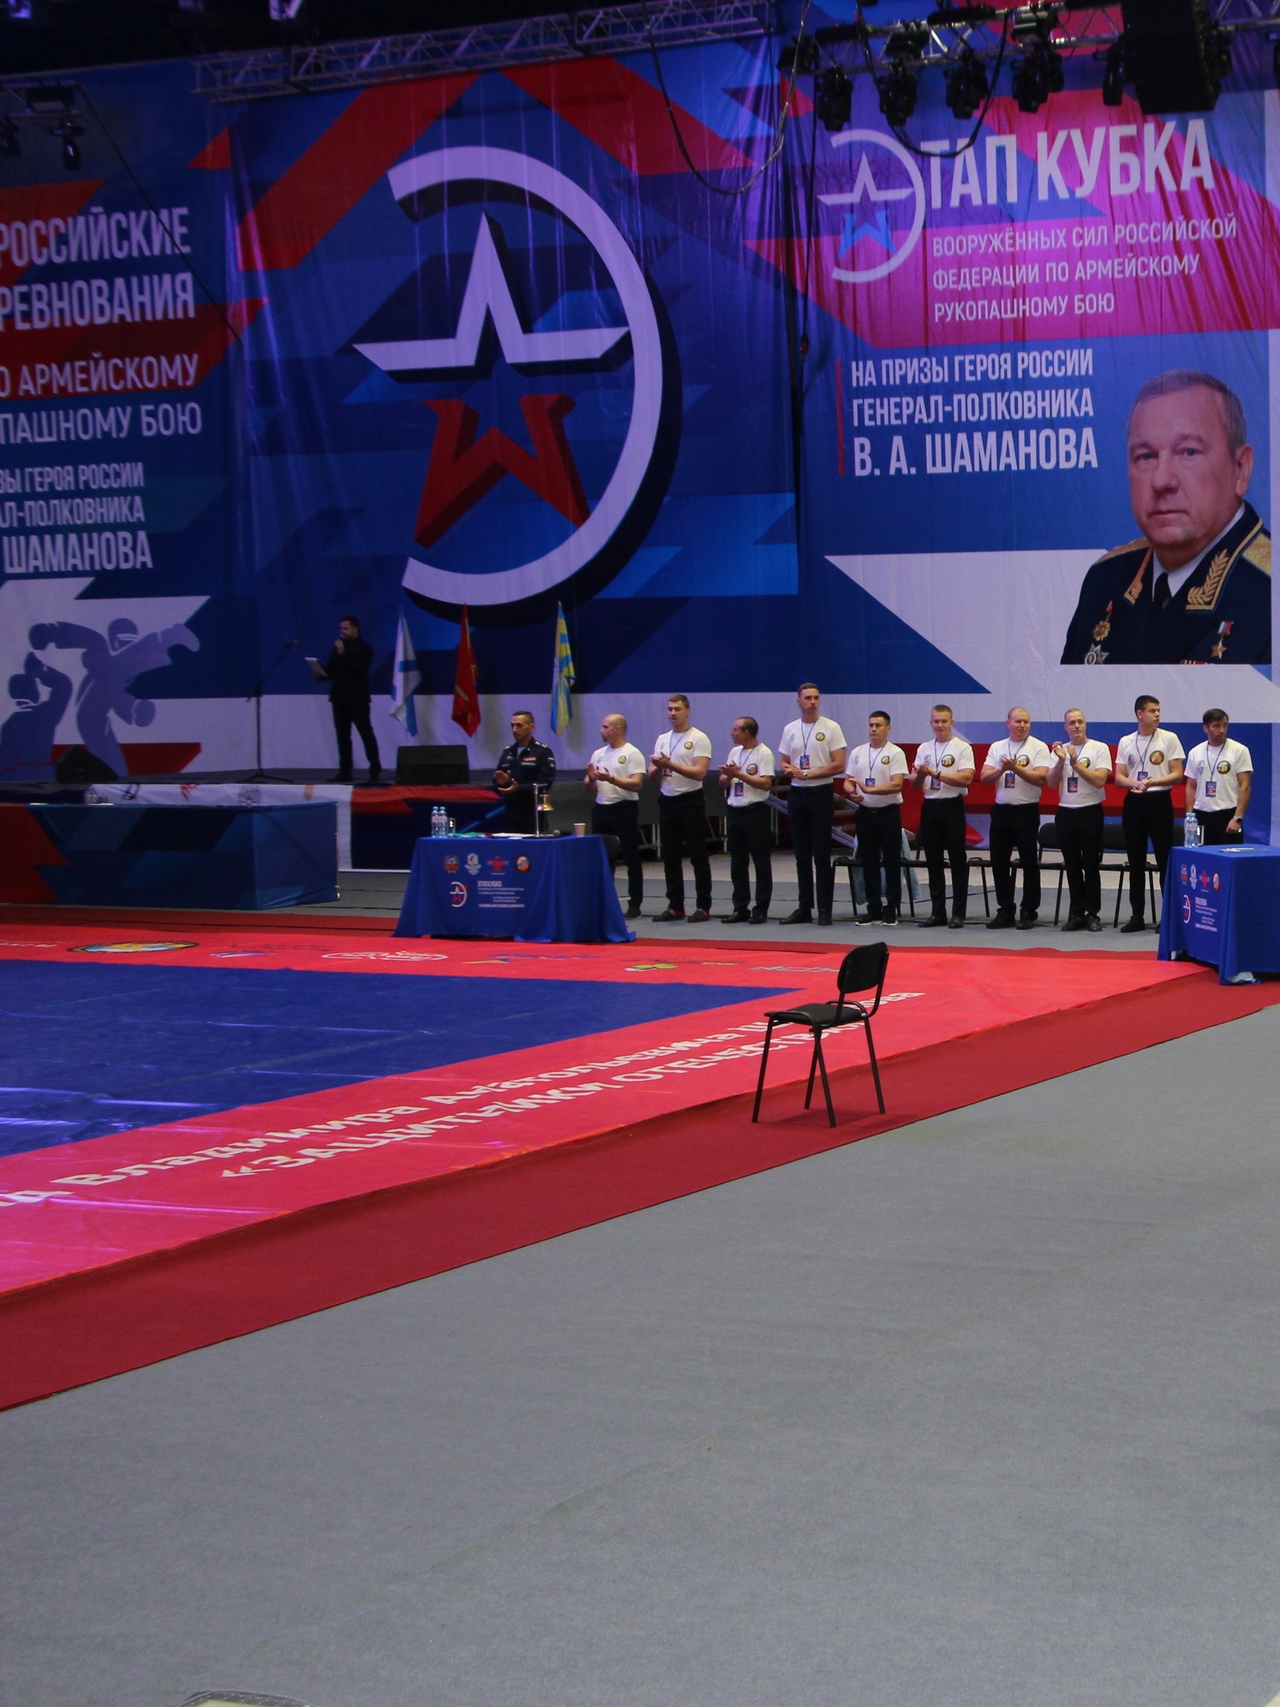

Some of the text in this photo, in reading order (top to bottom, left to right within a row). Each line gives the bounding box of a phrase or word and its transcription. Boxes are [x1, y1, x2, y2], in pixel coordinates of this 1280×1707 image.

[1037, 118, 1215, 201] КУБКА
[0, 206, 192, 269] РОССИЙСКИЕ
[932, 212, 1237, 257] ВООРУЖЁННЫХ СИЛ РОССИЙСКОЙ
[932, 253, 1200, 292] ФЕДЕРАЦИИ ПО АРМЕЙСКОМУ
[0, 272, 196, 332] РЕВНОВАНИЯ
[934, 292, 1115, 323] РУКОПАШНОМУ БОЮ
[18, 352, 200, 397] АРМЕЙСКОМУ
[851, 348, 1094, 387] НА ПРИЗЫ ГЕРОЯ РОССИИ
[0, 401, 202, 446] ПАШНОМУ БОЮ
[852, 387, 1094, 427] ГЕНЕРАЛ-ПОЛКОВНИКА
[854, 427, 1099, 477] В. А. ШАМАНОВА
[25, 464, 75, 493] ГЕРОЯ
[79, 462, 145, 490] РОССИИ
[3, 530, 154, 575] ШАМАНОВА
[50, 1104, 428, 1187] Владимира
[421, 1032, 747, 1106] Анатольевича
